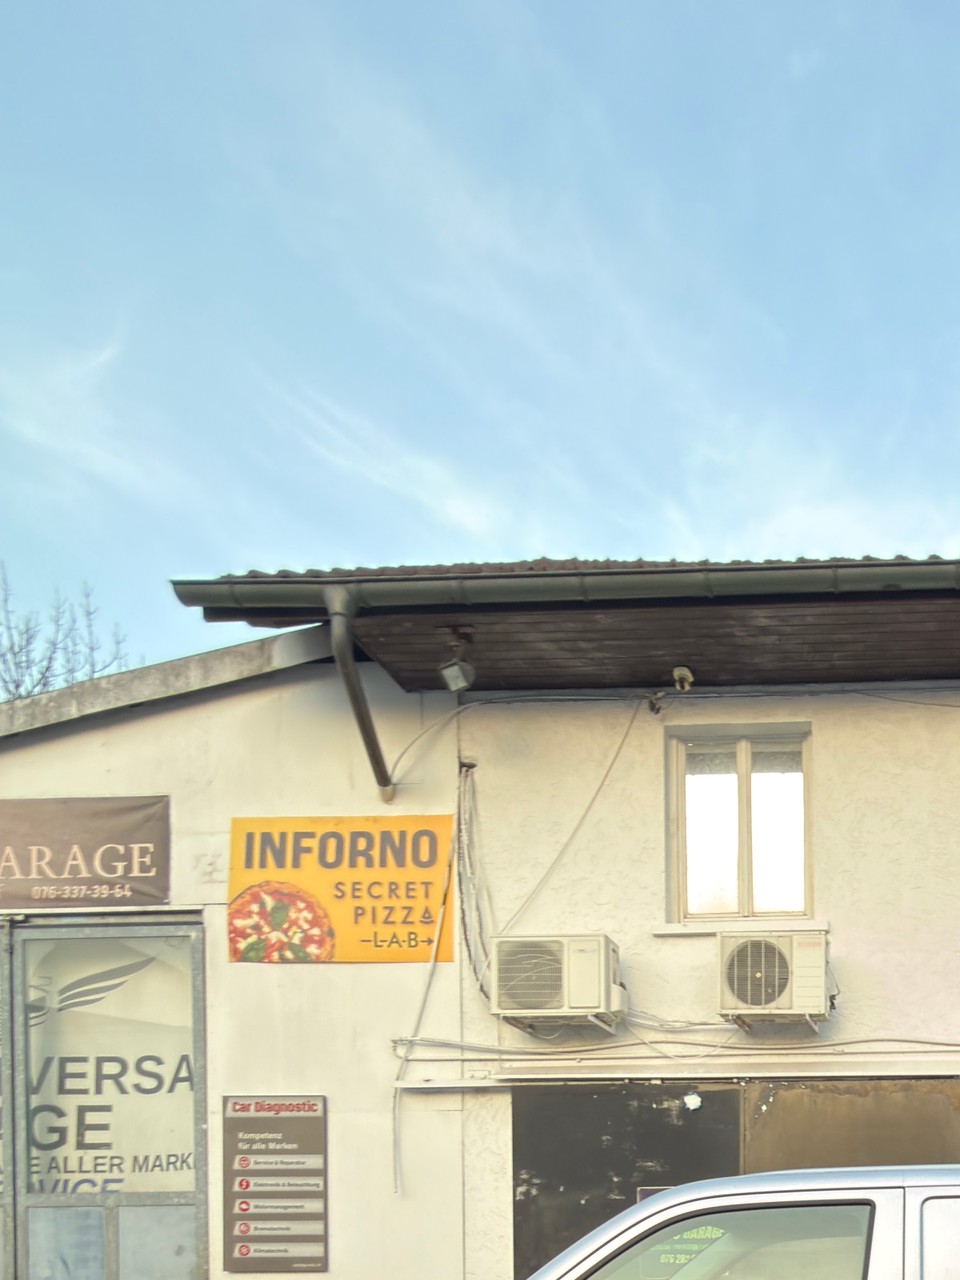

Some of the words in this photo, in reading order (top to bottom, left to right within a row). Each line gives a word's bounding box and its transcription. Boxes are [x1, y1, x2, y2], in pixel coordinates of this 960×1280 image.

[244, 829, 438, 869] INFORNO
[333, 881, 434, 899] SECRET
[354, 906, 435, 925] PIZZA
[231, 1101, 251, 1113] Car
[254, 1101, 318, 1115] Diagnostic
[47, 1156, 124, 1174] ALLER
[132, 1152, 196, 1173] MARK
